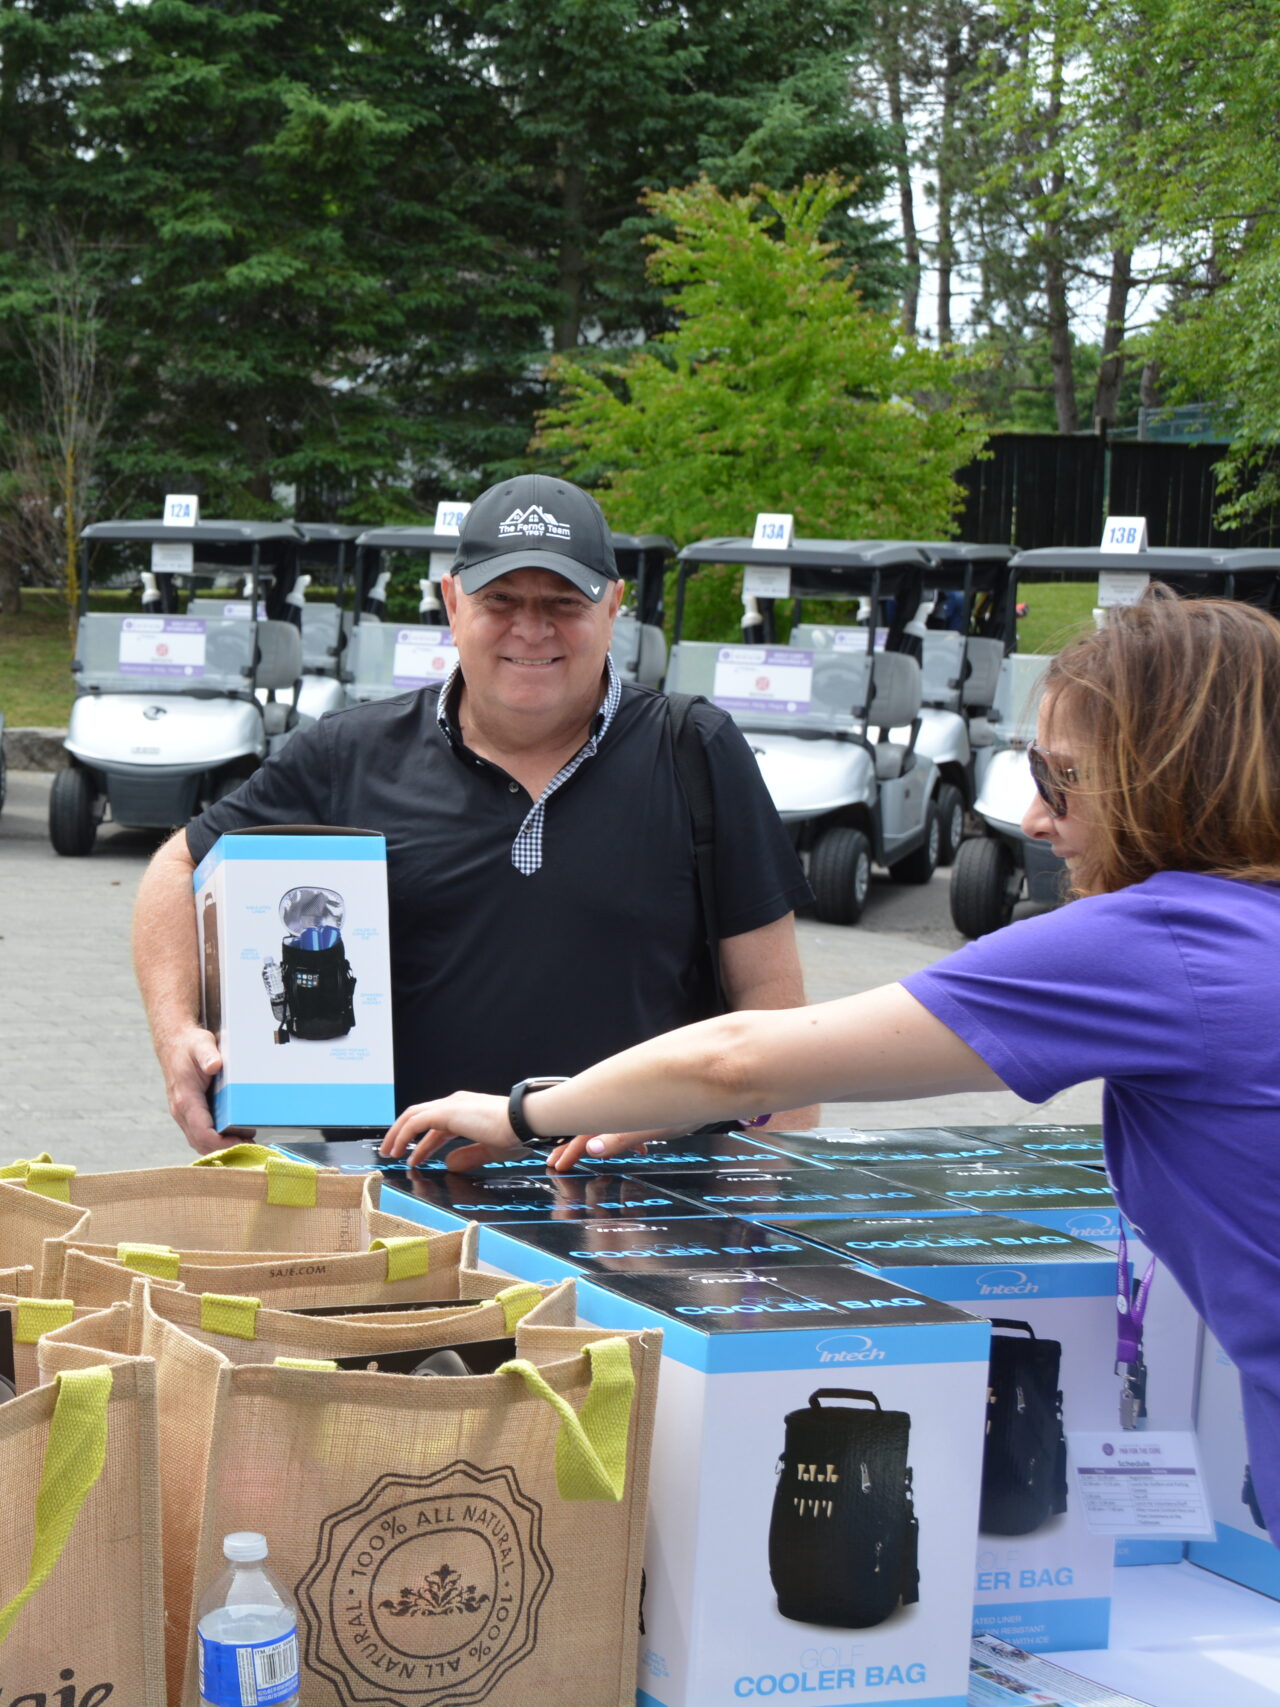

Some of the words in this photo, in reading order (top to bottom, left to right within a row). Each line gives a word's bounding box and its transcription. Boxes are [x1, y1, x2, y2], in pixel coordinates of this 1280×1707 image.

[170, 503, 190, 518] 12A
[499, 524, 515, 533] The
[517, 523, 545, 532] FernG
[547, 524, 570, 535] Team
[761, 523, 784, 540] 13A
[1109, 527, 1137, 544] 13B
[580, 1156, 708, 1164] COOLER
[710, 1154, 781, 1162] BAG
[811, 1152, 933, 1161] COOLER
[936, 1149, 1003, 1159] BAG
[703, 1194, 839, 1202] COOLER
[843, 1191, 917, 1199] BAG
[945, 1187, 1073, 1198] COOLER
[1075, 1186, 1113, 1195] BA
[452, 1203, 593, 1211] COOLER
[597, 1198, 673, 1209] BAG
[597, 1225, 668, 1233] Intech
[1070, 1224, 1121, 1237] Intech
[845, 1238, 992, 1249] COOLER
[990, 1235, 1072, 1245] BAG
[568, 1248, 719, 1259] COOLER
[720, 1244, 803, 1254] BAG
[269, 1266, 326, 1278] SAJE.COM
[701, 1276, 778, 1284] Intech
[979, 1281, 1039, 1295] Intech
[675, 1303, 837, 1315] COOLER
[837, 1297, 927, 1310] BAG
[819, 1348, 886, 1363] Intech
[351, 1516, 407, 1577] 100%
[417, 1507, 454, 1527] ALL
[463, 1505, 514, 1573] NATURAL
[1020, 1567, 1074, 1588] BAG
[997, 1615, 1022, 1624] LINER
[470, 1594, 513, 1662] 100%
[346, 1600, 416, 1679] NATURAL
[799, 1644, 865, 1670] GOLF
[425, 1658, 460, 1679] ALL
[734, 1668, 856, 1698] COOLER
[865, 1662, 927, 1687] BAG
